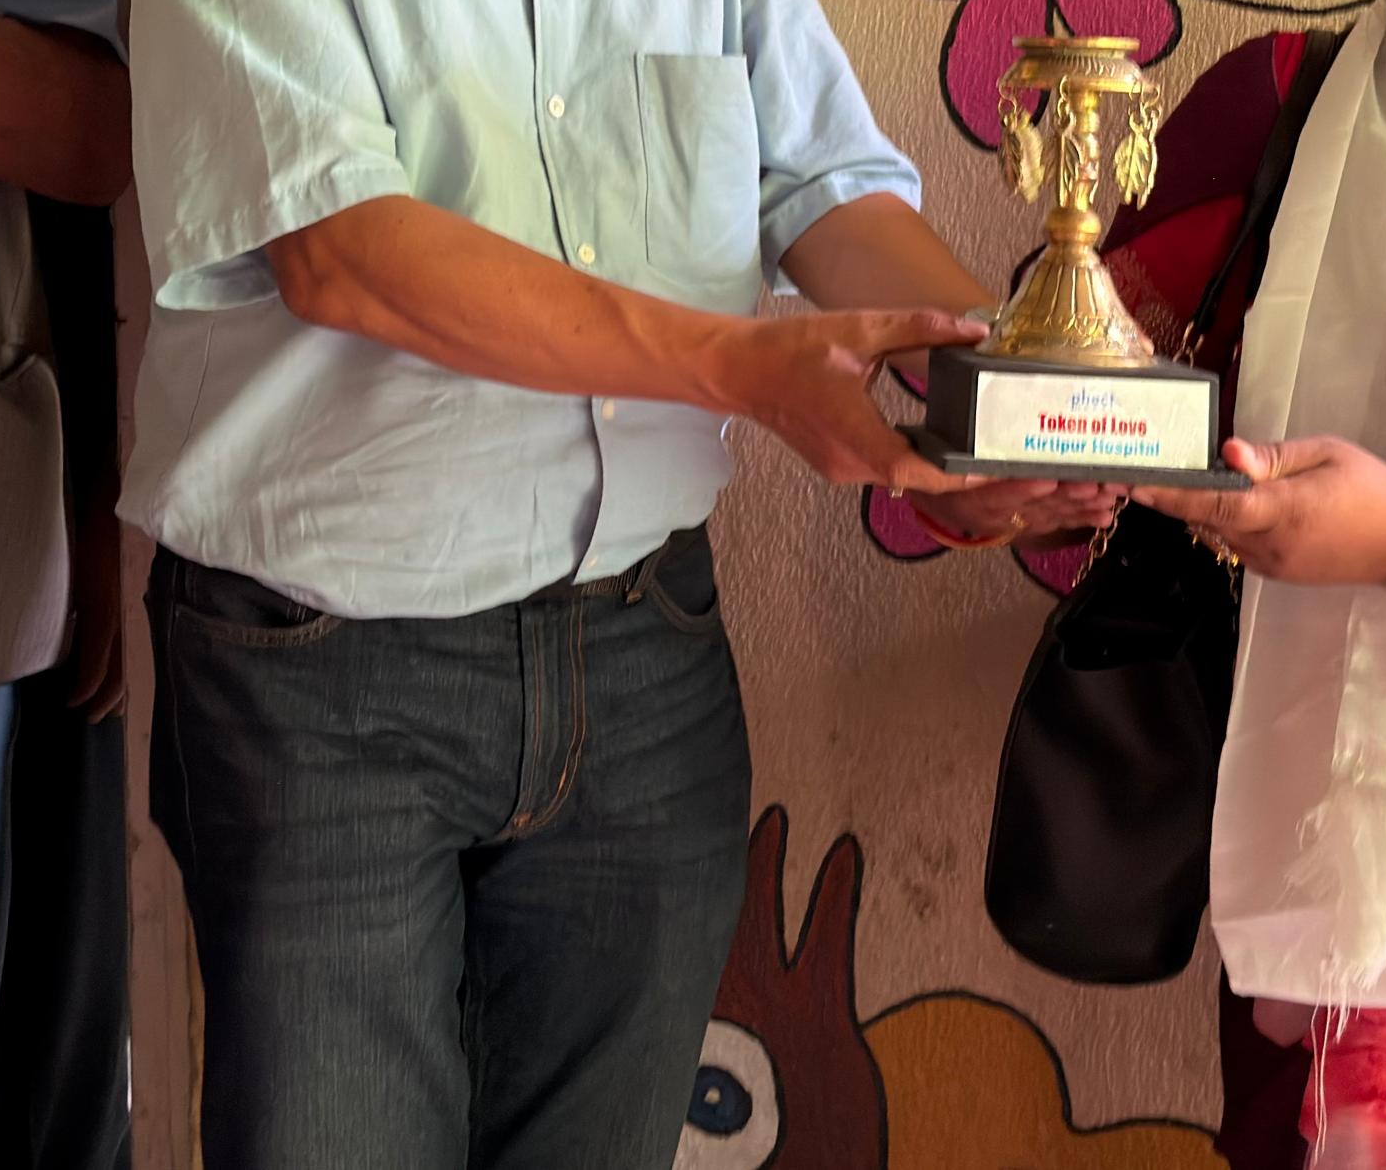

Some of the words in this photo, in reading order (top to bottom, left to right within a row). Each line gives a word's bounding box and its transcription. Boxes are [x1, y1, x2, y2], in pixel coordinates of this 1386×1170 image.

[1039, 413, 1088, 434] Token
[1091, 415, 1107, 435] of
[1111, 416, 1148, 437] Love
[1024, 434, 1087, 455] Kirtipur
[1092, 437, 1161, 458] Hospital
